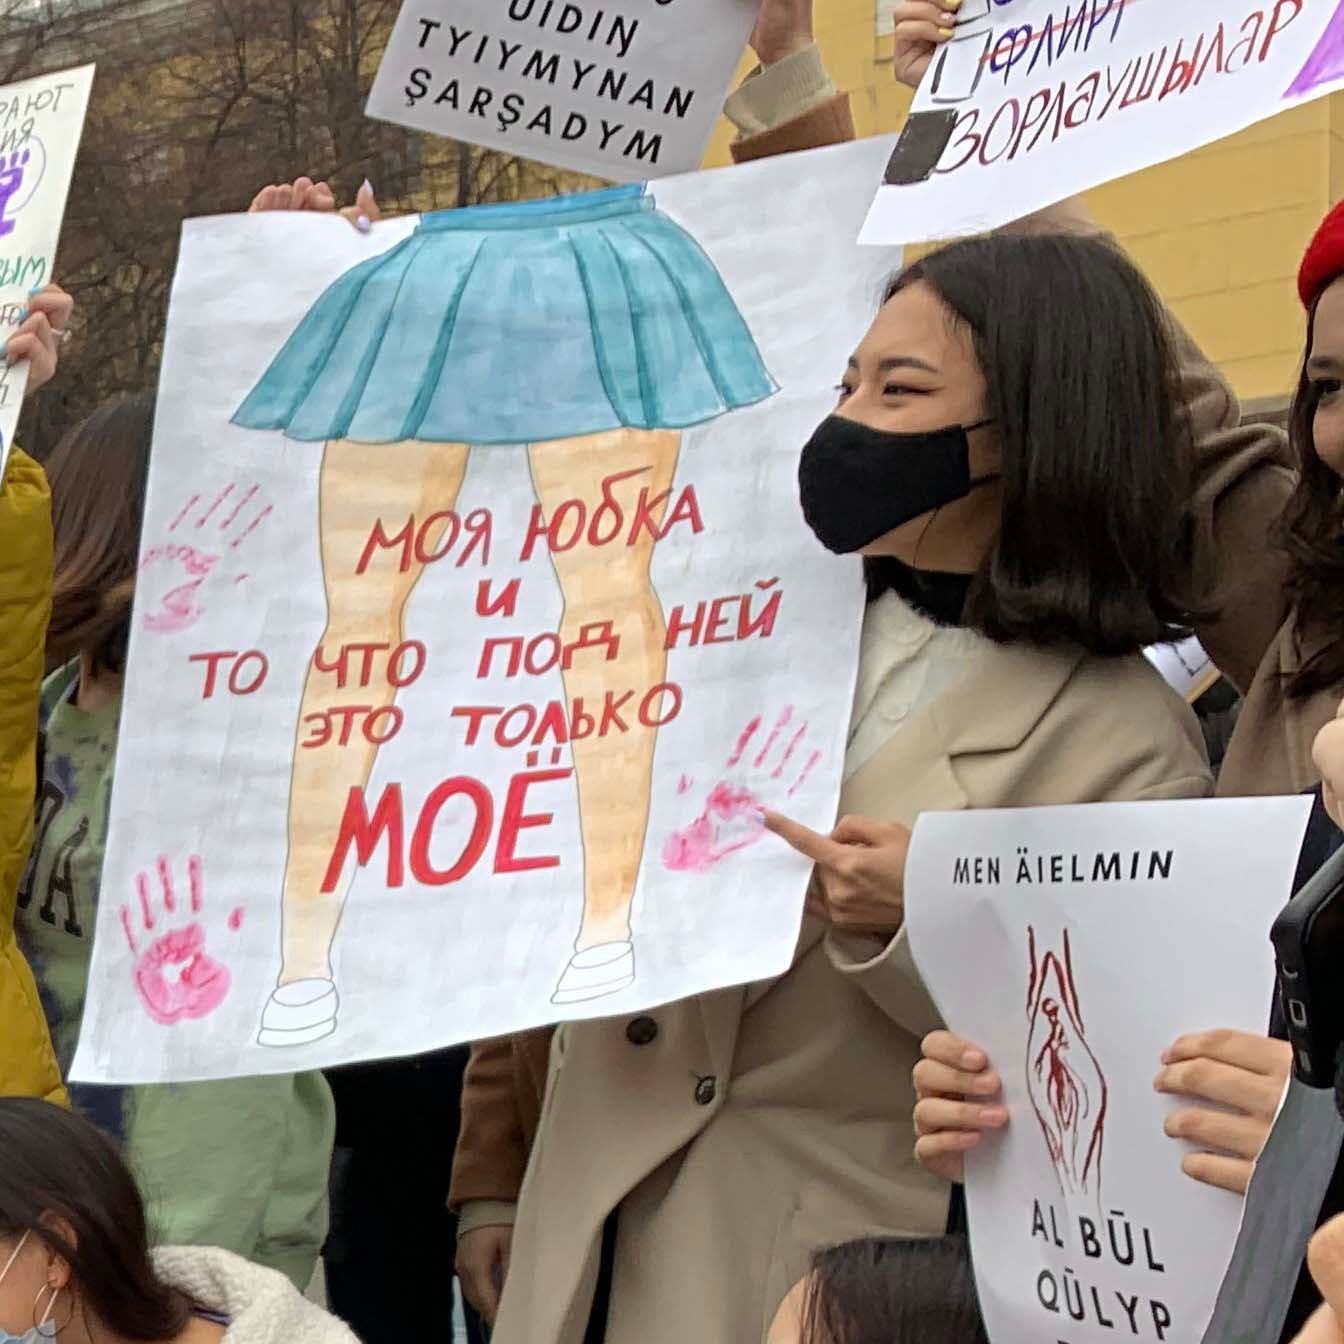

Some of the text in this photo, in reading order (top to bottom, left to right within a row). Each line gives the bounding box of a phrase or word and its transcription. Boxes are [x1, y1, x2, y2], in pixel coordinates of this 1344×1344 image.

[417, 18, 695, 119] TYIYMYNAN
[355, 507, 493, 577] МОЯ
[475, 578, 521, 618] И
[189, 576, 784, 700] ТО ЧТО ПОД НЕЙ
[301, 680, 683, 749] ЭТО ТОЛЬКО
[319, 750, 574, 894] МОЁ
[953, 848, 1174, 884] MEN ÄIELMIN
[1030, 1198, 1064, 1249] AL
